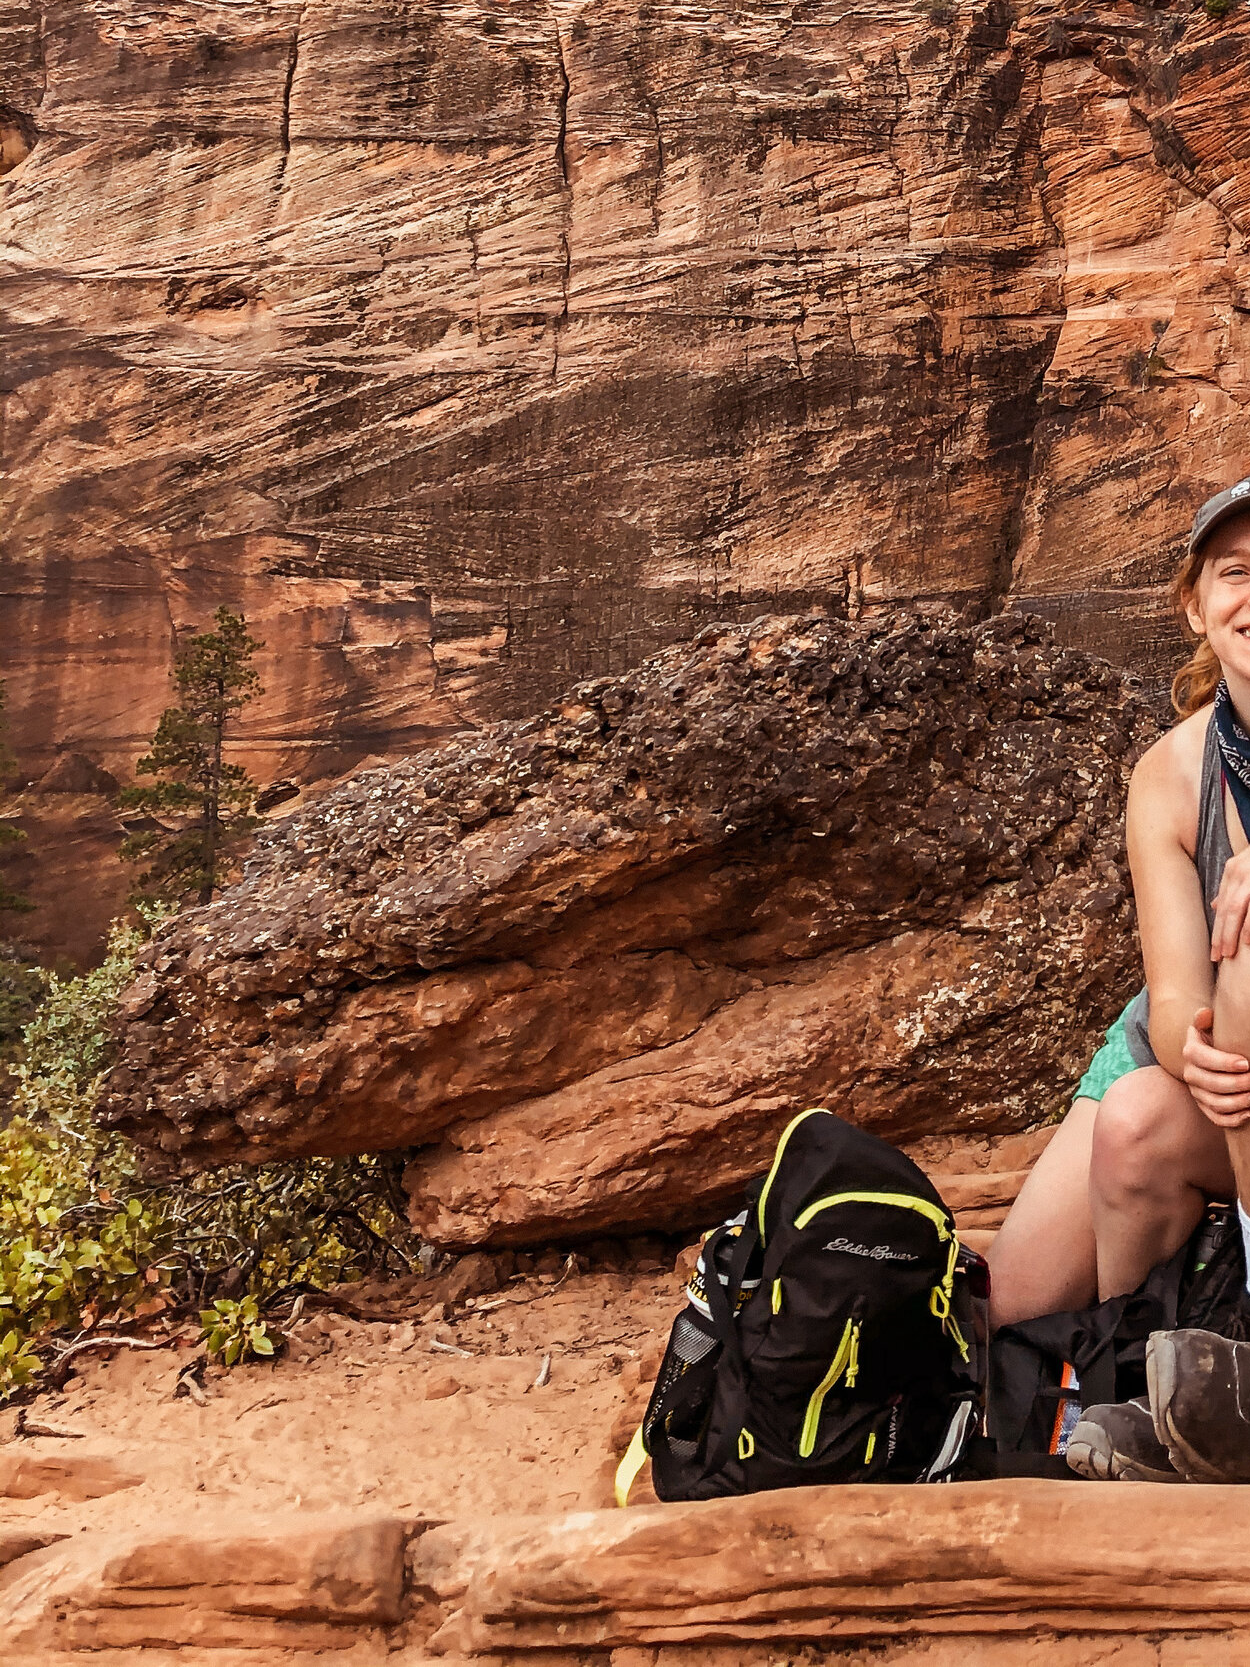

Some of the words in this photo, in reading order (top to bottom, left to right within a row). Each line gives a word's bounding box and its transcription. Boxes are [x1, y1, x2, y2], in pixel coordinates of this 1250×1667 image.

[822, 1237, 869, 1256] Eddie
[869, 1245, 918, 1261] Bauer
[886, 1406, 898, 1464] OWAWAY
